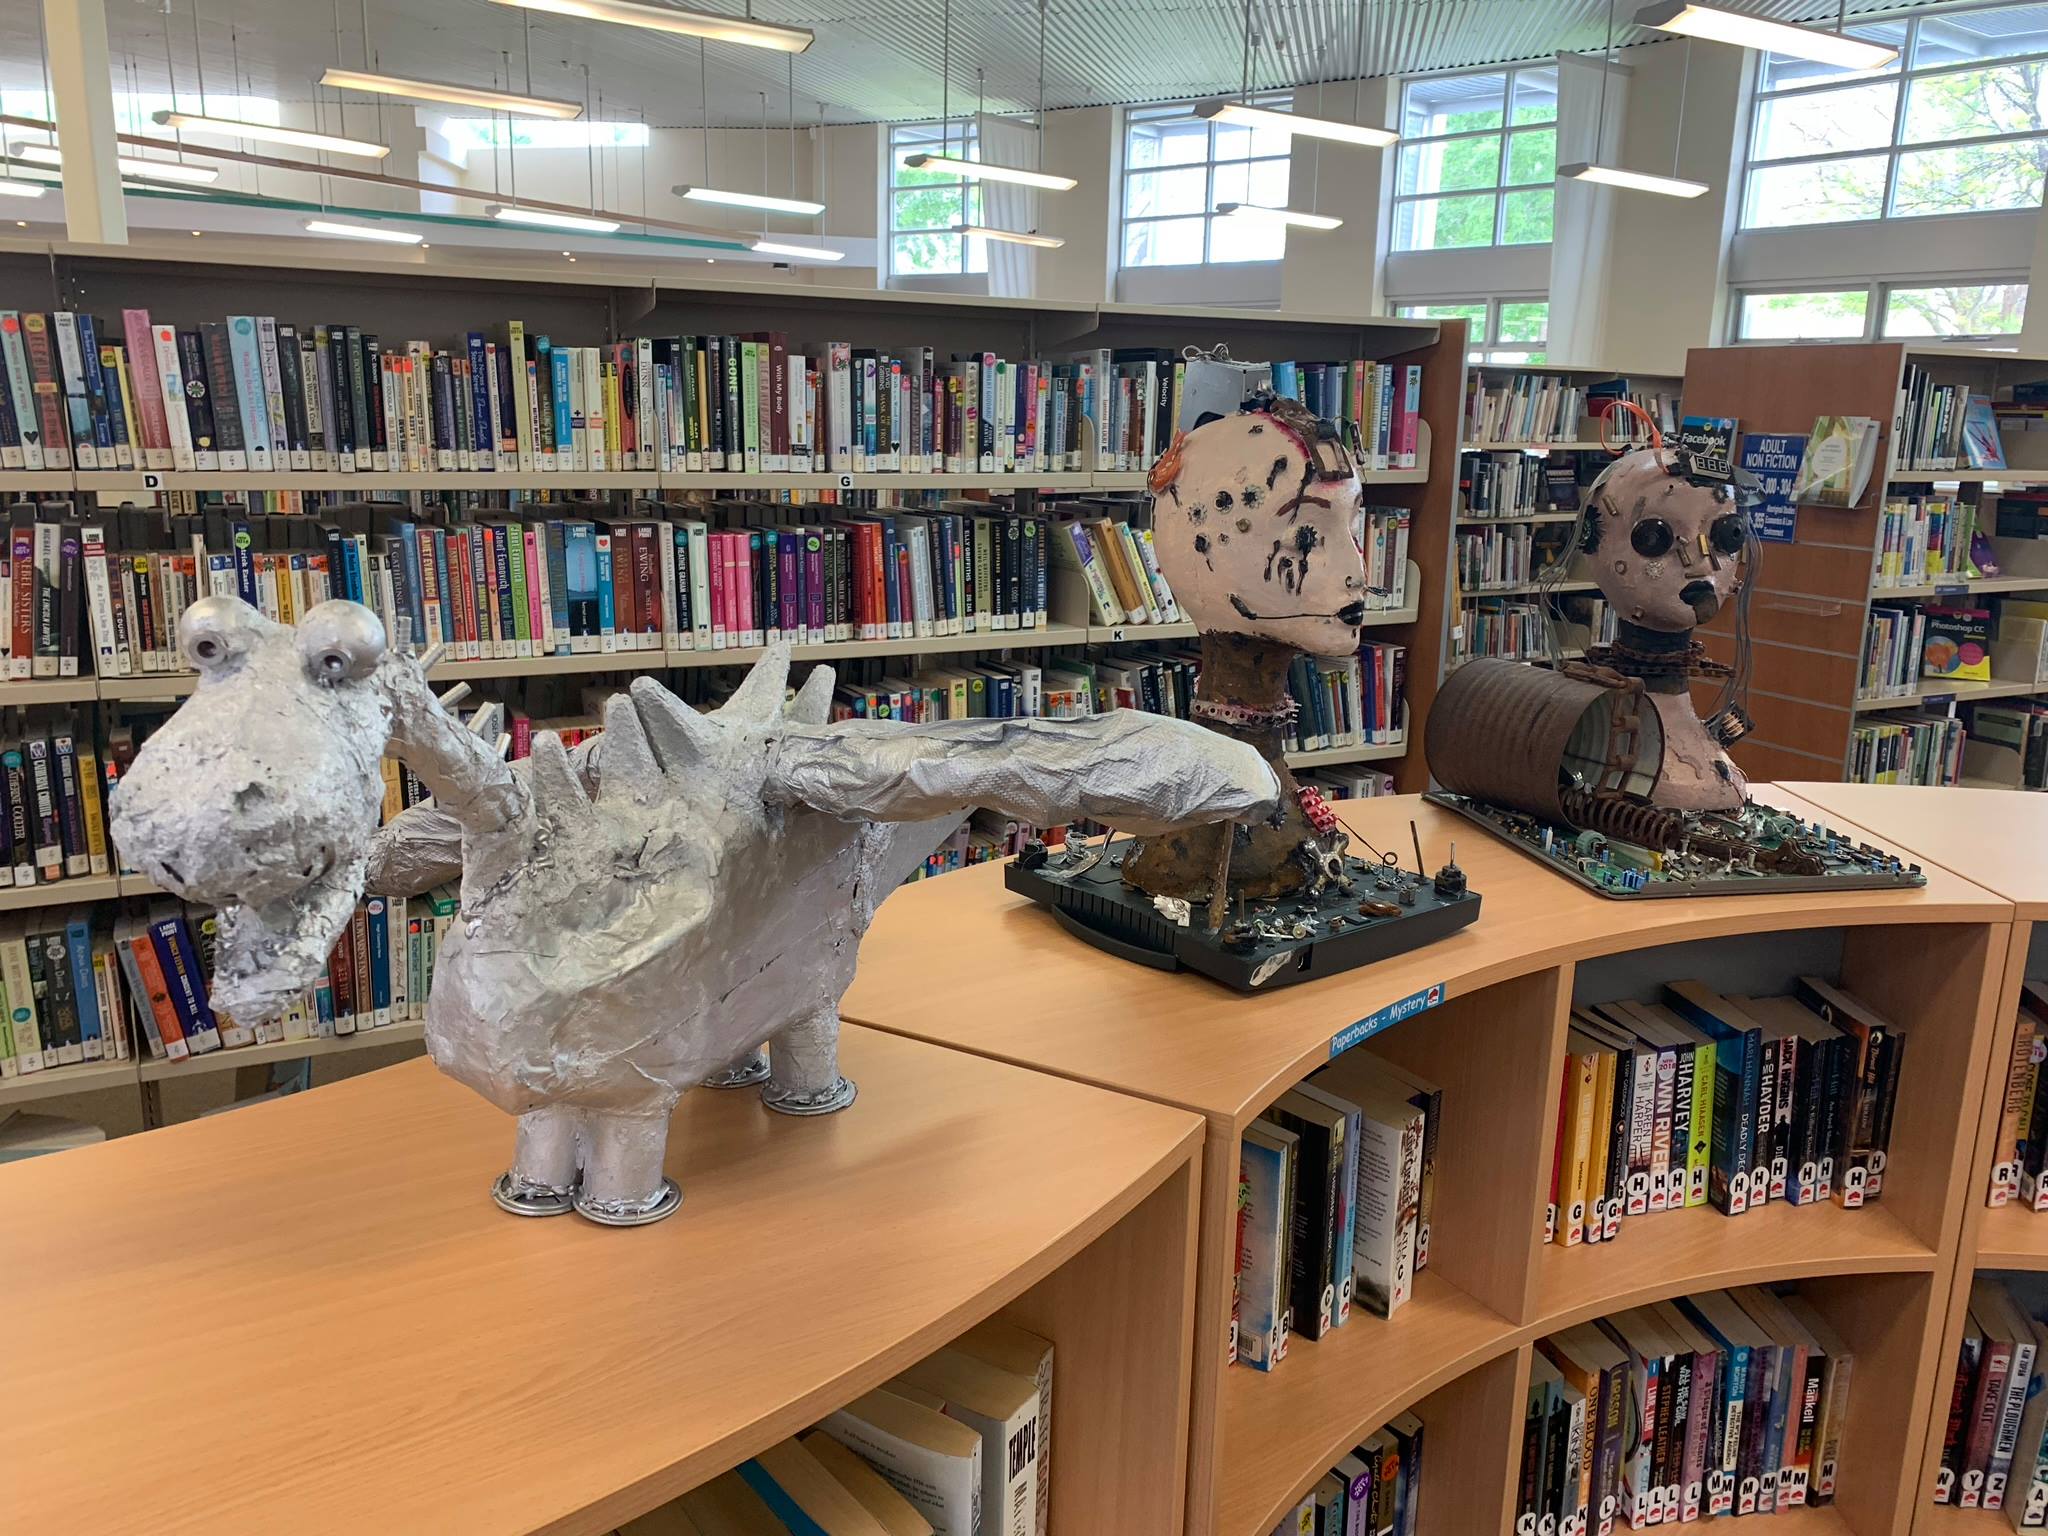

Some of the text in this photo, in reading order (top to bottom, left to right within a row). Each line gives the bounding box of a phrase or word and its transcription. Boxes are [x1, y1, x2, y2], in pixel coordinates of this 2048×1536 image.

[728, 358, 737, 393] GONE
[775, 383, 782, 394] My
[1160, 377, 1169, 407] Velocity
[1682, 433, 1726, 446] Facebook
[1760, 439, 1787, 453] ADULT
[1746, 453, 1765, 467] NON
[1765, 454, 1797, 470] FICTION
[146, 476, 158, 488] D
[841, 476, 850, 487] G
[472, 527, 485, 581] JANET EVANOVICH
[495, 530, 509, 589] Janet Evanovich
[934, 549, 942, 568] WARD
[421, 535, 435, 598] JANET EVANOVICH
[639, 547, 648, 582] EWING
[678, 547, 688, 593] HEATHER GRAHAM
[241, 569, 250, 593] Easter
[391, 551, 404, 605] GATHERING
[21, 592, 32, 634] SISTERS
[42, 623, 51, 645] LAWYER
[117, 619, 125, 639] DUNN
[1114, 631, 1122, 640] K
[1931, 622, 1985, 633] Photoshop CC
[34, 759, 52, 817] CATHERINE COULTER
[13, 805, 26, 839] COULTER
[76, 944, 89, 989] ANNA DAVIS
[180, 975, 193, 996] CONSENT
[188, 1005, 198, 1015] KILL
[1332, 995, 1426, 1051] Paperbacks Mystery
[1681, 1052, 1695, 1063] JOHN
[1778, 1038, 1794, 1110] JACK HIGGINS
[2007, 1040, 2033, 1114] ROTENBERG
[1742, 1060, 1752, 1106] HANNAH
[1675, 1063, 1694, 1131] HARVEY
[1757, 1075, 1772, 1135] HAYDER
[1698, 1075, 1709, 1137] CARL HIAASEN
[1632, 1096, 1645, 1143] HARPER
[1644, 1098, 1653, 1137] KAREN
[1739, 1113, 1748, 1150] DEADLY
[1404, 1127, 1416, 1158] CLIVE
[1774, 1161, 1784, 1175] H
[1822, 1161, 1832, 1176] H
[1872, 1156, 1882, 1170] H
[1673, 1173, 1683, 1188] H
[1694, 1169, 1704, 1184] H
[1756, 1171, 1766, 1186] H
[1803, 1167, 1812, 1181] H
[1851, 1172, 1862, 1186] H
[2000, 1168, 2008, 1180] R
[1634, 1177, 1644, 1191] H
[1656, 1175, 1666, 1190] H
[1735, 1175, 1745, 1190] H
[1572, 1204, 1582, 1220] G
[1608, 1203, 1617, 1217] G
[1421, 1229, 1428, 1245] C
[1398, 1264, 1404, 1280] C
[1325, 1289, 1331, 1304] C
[1343, 1281, 1350, 1297] C
[1283, 1316, 1288, 1334] B
[1732, 1366, 1741, 1397] MORTON
[1607, 1370, 1622, 1428] LARSSON
[1802, 1378, 1819, 1422] Mankell
[1981, 1379, 2001, 1424] TAKE OUT
[1644, 1386, 1656, 1431] LIAR, LIAR
[1656, 1385, 1671, 1464] STEPHEN LEATHER
[1998, 1387, 2026, 1453] THE PLOUGHMEN
[1583, 1387, 1598, 1471] ONE BLOOD
[1725, 1405, 1737, 1465] DETECTIVE AGENCY
[1009, 1416, 1036, 1483] TEMPLE
[1569, 1426, 1583, 1464] KING
[1781, 1470, 1792, 1482] M
[1822, 1464, 1833, 1476] M
[1712, 1475, 1720, 1488] M
[1723, 1479, 1732, 1491] M
[1764, 1477, 1775, 1489] M
[1794, 1473, 1806, 1485] M
[1970, 1475, 1980, 1486] Y
[1993, 1478, 2004, 1490] Z
[1669, 1489, 1676, 1501] L
[1691, 1487, 1697, 1499] L
[1743, 1482, 1753, 1494] M
[2035, 1489, 2043, 1502] A
[1639, 1498, 1645, 1510] L
[1654, 1492, 1661, 1503] L
[1579, 1508, 1586, 1521] K
[1605, 1502, 1611, 1514] L
[1524, 1518, 1533, 1530] K
[1544, 1518, 1553, 1530] K
[1565, 1520, 1574, 1533] K
